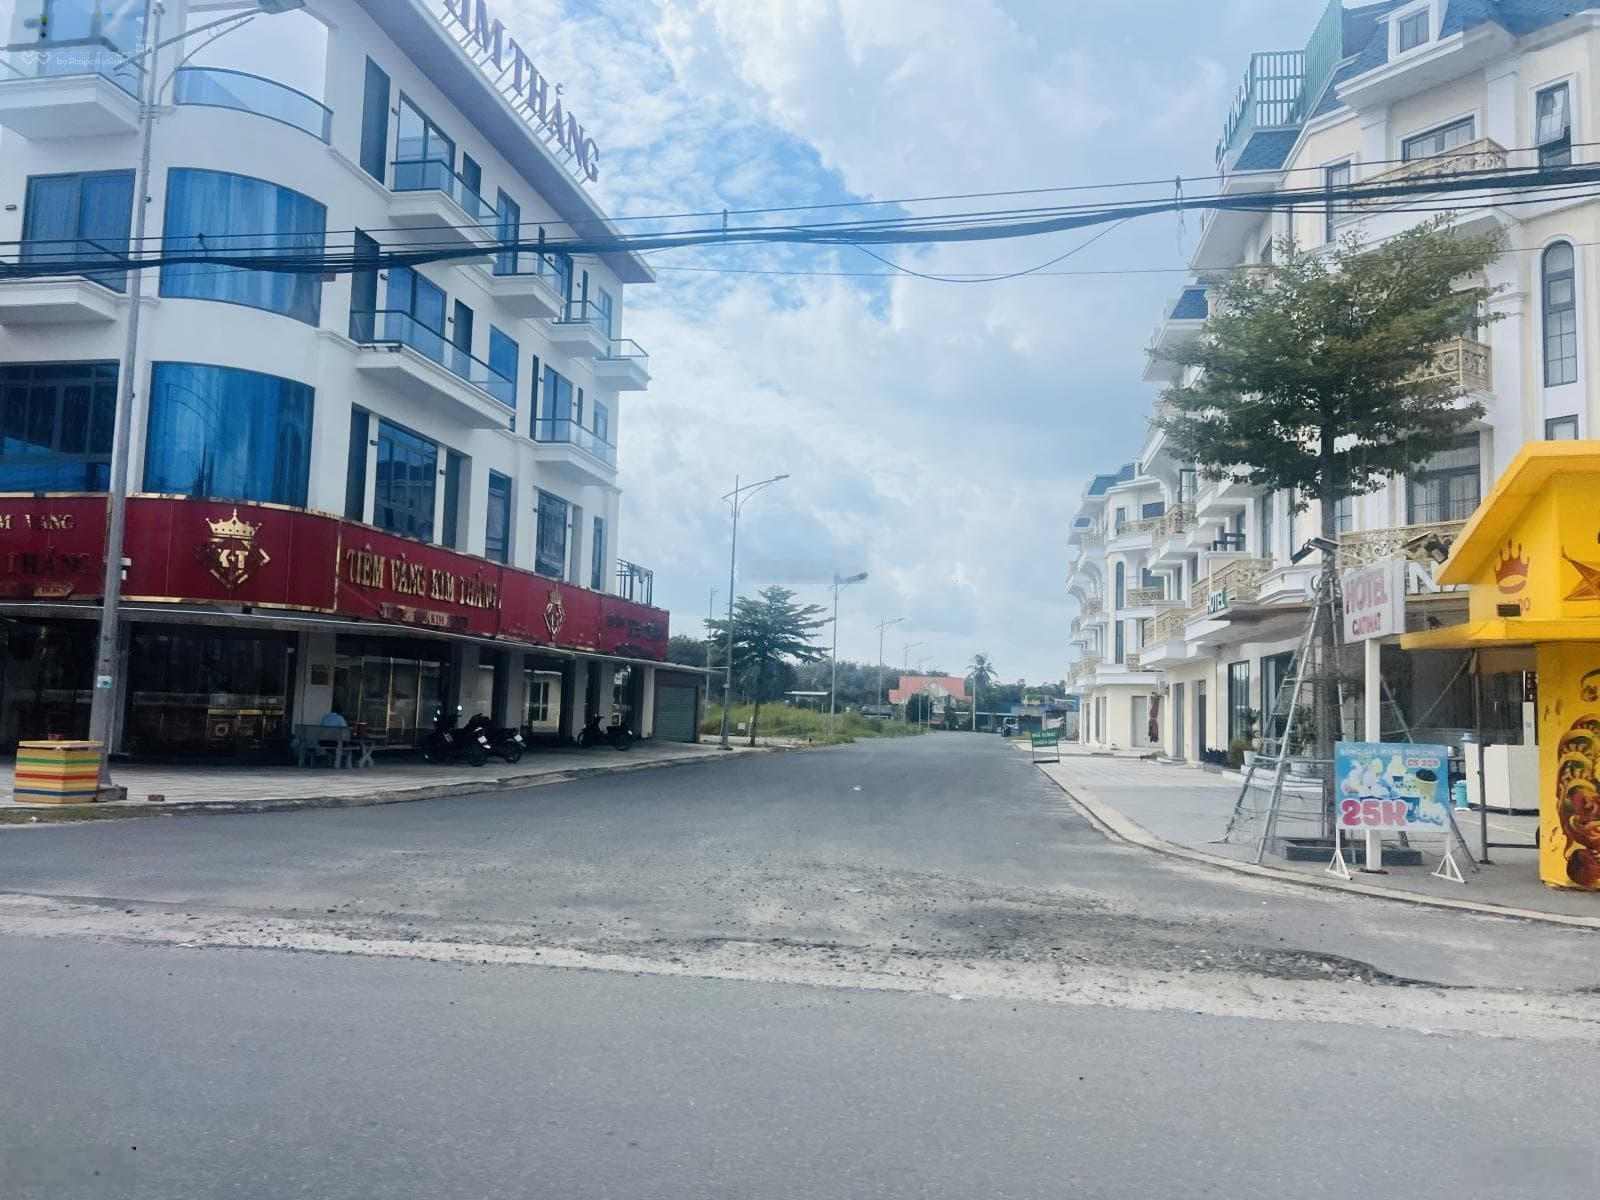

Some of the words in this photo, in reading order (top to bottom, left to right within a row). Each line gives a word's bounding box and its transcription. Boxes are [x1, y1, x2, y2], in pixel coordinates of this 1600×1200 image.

[431, 568, 455, 602] KIM
[1345, 567, 1388, 614] HOTEL
[1206, 588, 1225, 615] HOTEL
[1340, 799, 1408, 827] 25K
